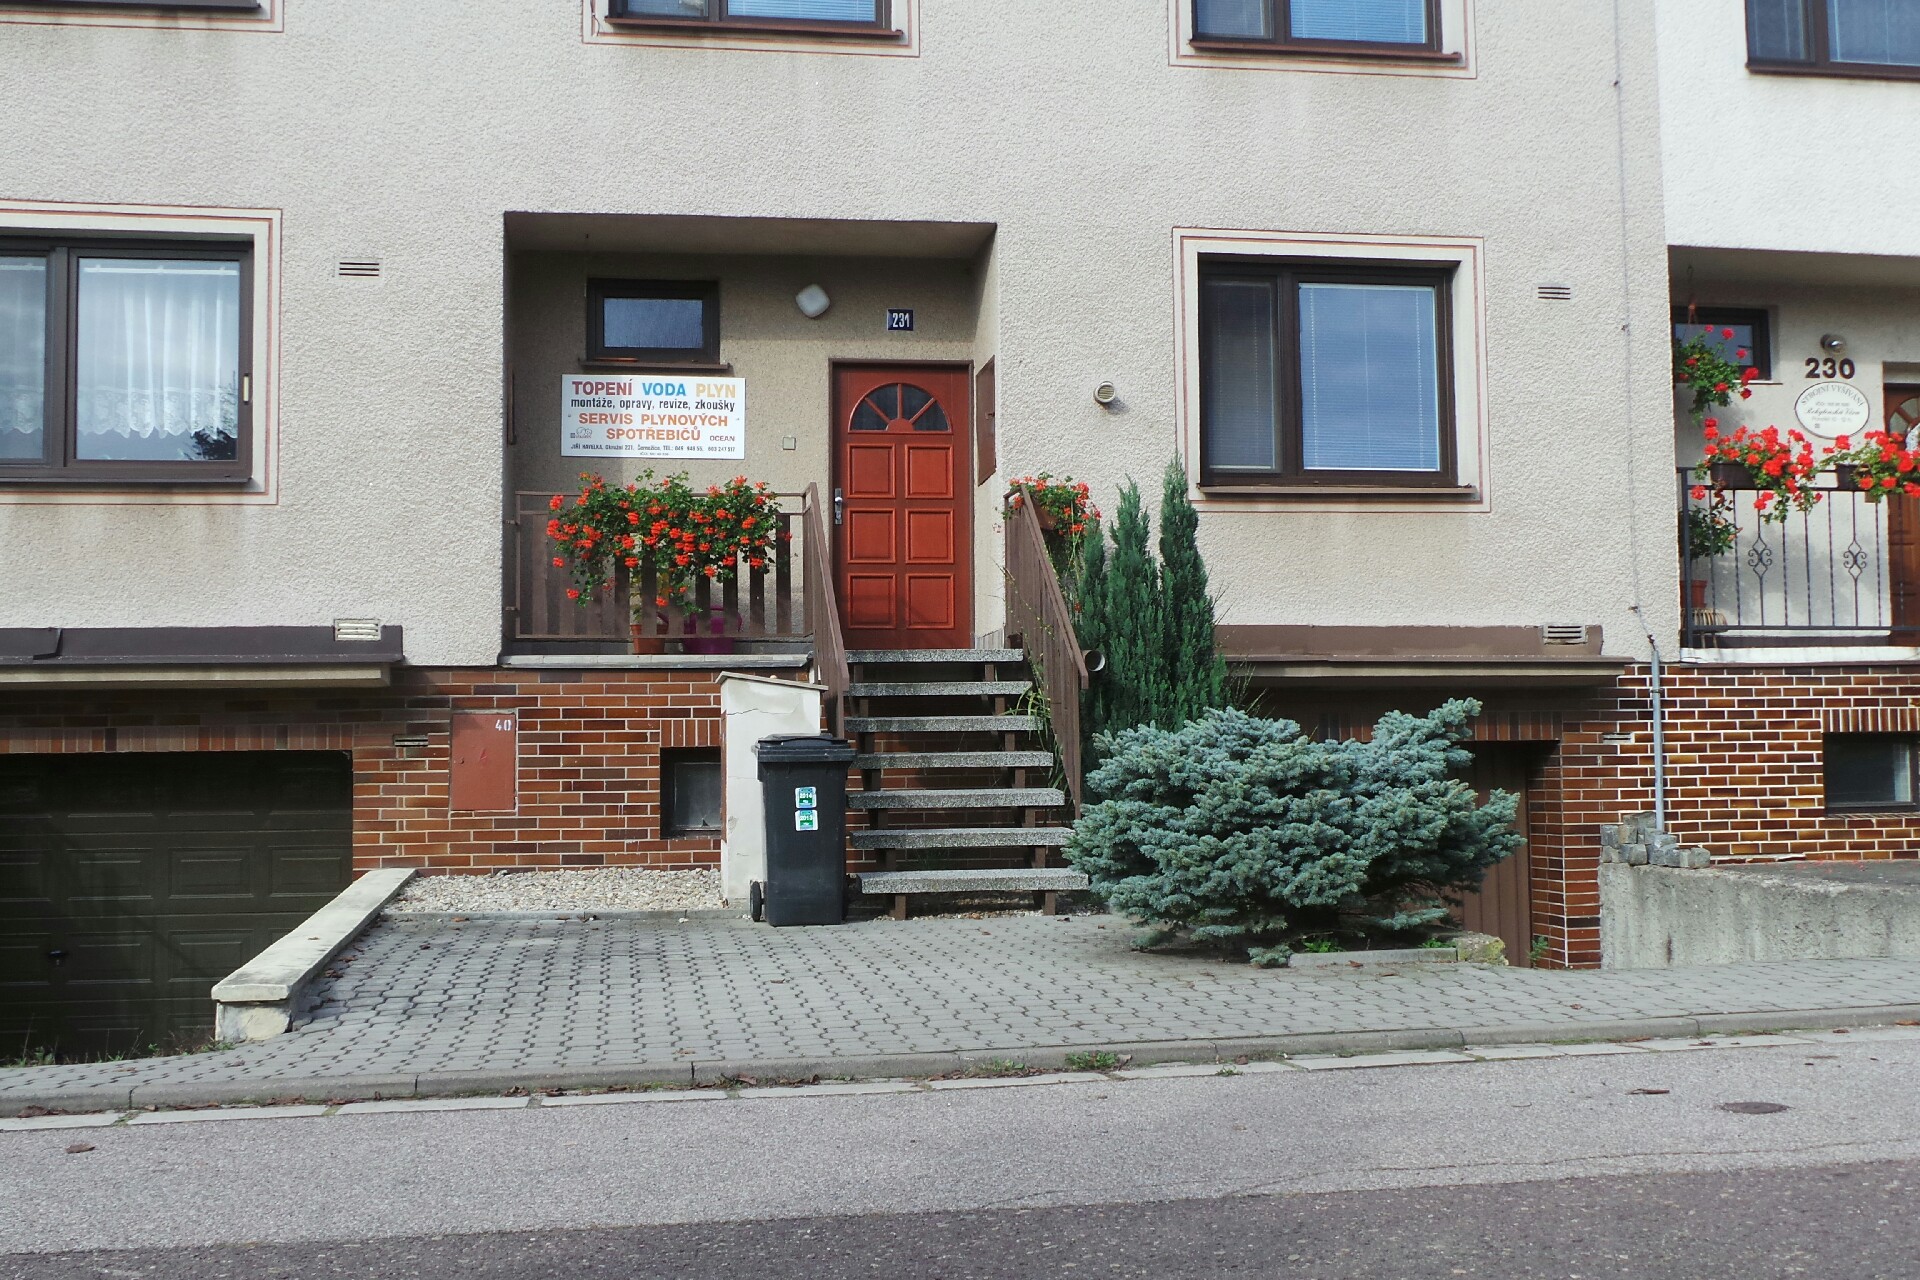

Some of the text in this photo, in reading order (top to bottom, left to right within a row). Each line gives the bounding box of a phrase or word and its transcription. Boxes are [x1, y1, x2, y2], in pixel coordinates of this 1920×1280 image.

[892, 312, 910, 328] 231
[1804, 357, 1855, 380] 230
[571, 379, 736, 398] TOPENÍ VODA PLYN
[1802, 385, 1829, 404] STROJNÍ
[570, 397, 736, 412] montáže, opravy, revize, zkoušky
[578, 412, 728, 427] SERVIS PLYNOVÝCH
[606, 426, 701, 441] SPOTŘEBIČŮ
[495, 719, 512, 731] 40
